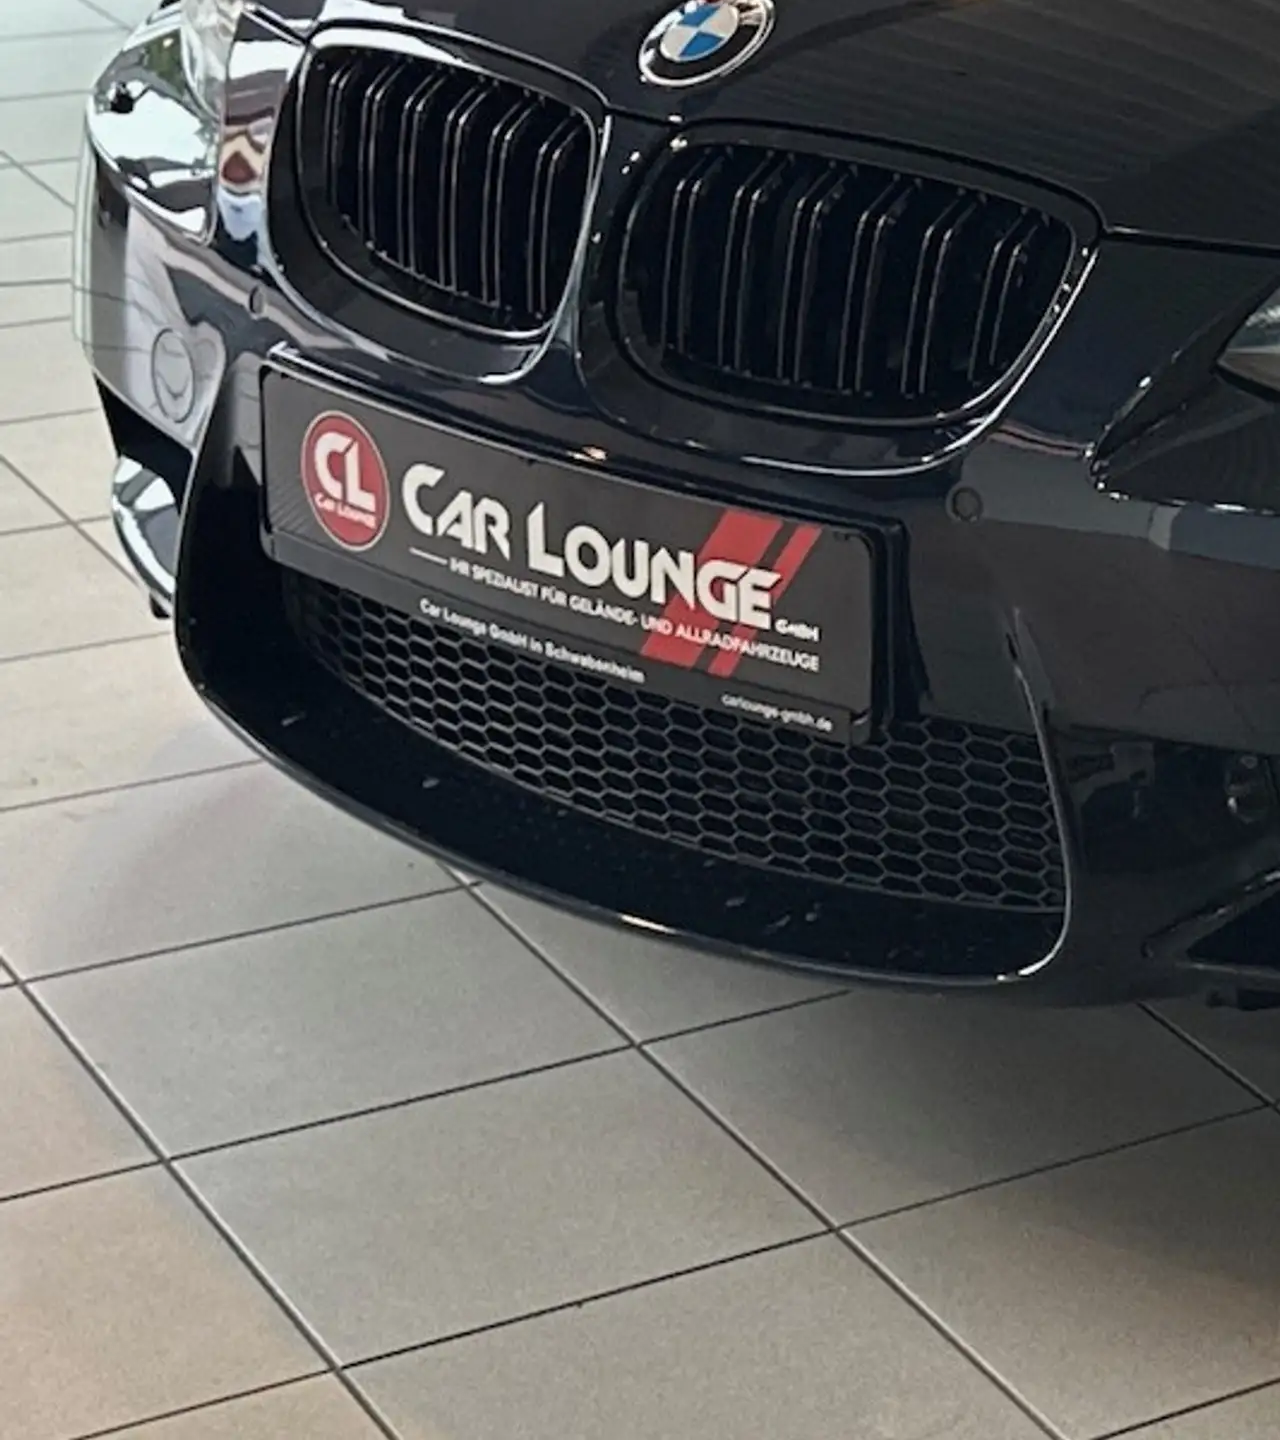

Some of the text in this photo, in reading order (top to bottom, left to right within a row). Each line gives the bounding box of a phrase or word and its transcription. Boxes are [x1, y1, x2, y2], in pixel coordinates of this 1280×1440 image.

[314, 431, 376, 513] CL
[420, 598, 646, 684] Car Lounge GmbH in Schwabenheim
[450, 557, 820, 672] IHR SPEZIALIST FÜR GELÄNDE- UND ALLRADFAHRZEUGE
